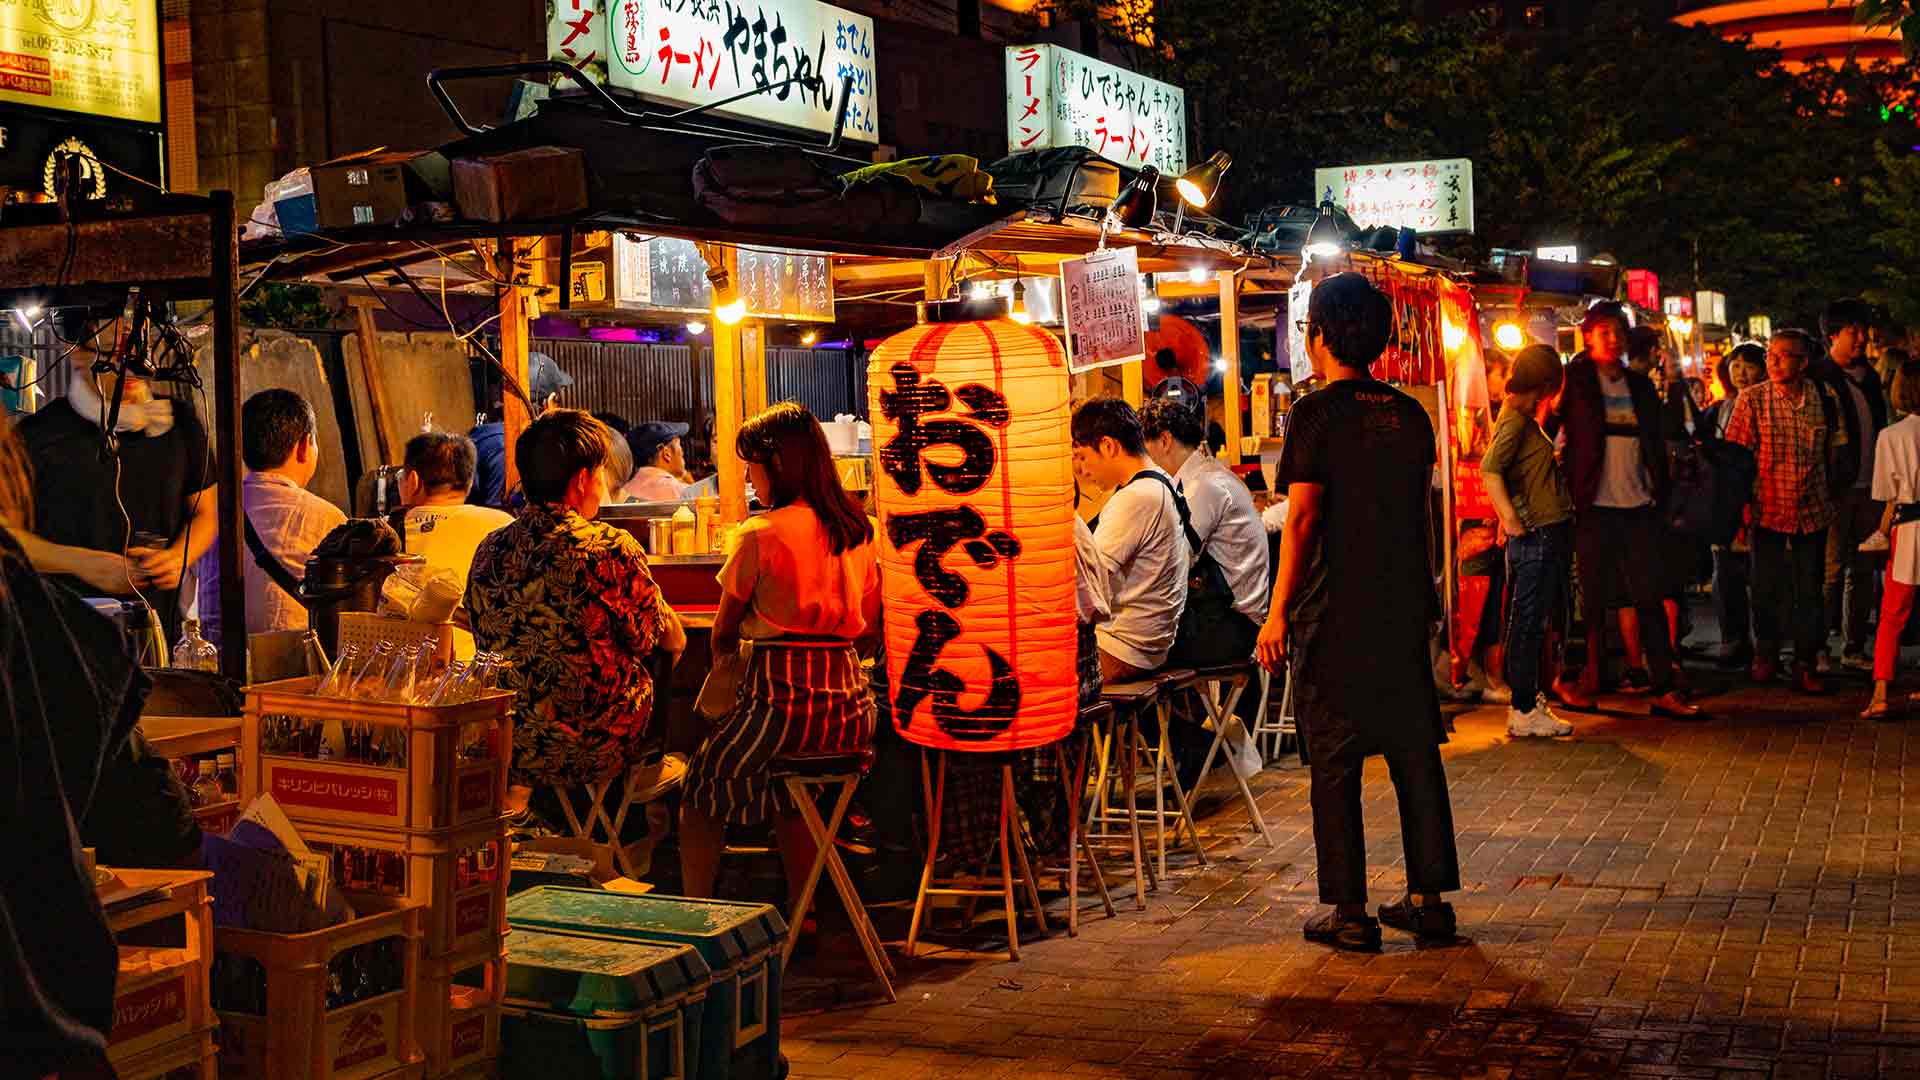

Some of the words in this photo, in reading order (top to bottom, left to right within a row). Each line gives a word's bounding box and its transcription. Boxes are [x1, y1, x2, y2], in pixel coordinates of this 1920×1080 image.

[658, 26, 720, 90] ラーメン
[723, 1, 833, 112] やまちゃん
[836, 20, 871, 58] おでん
[1016, 47, 1044, 148] ラーメン
[1082, 66, 1151, 117] ひでちゃん
[1094, 116, 1150, 162] ラーメン
[1154, 147, 1184, 175] 明太子
[879, 361, 1022, 741] おでん
